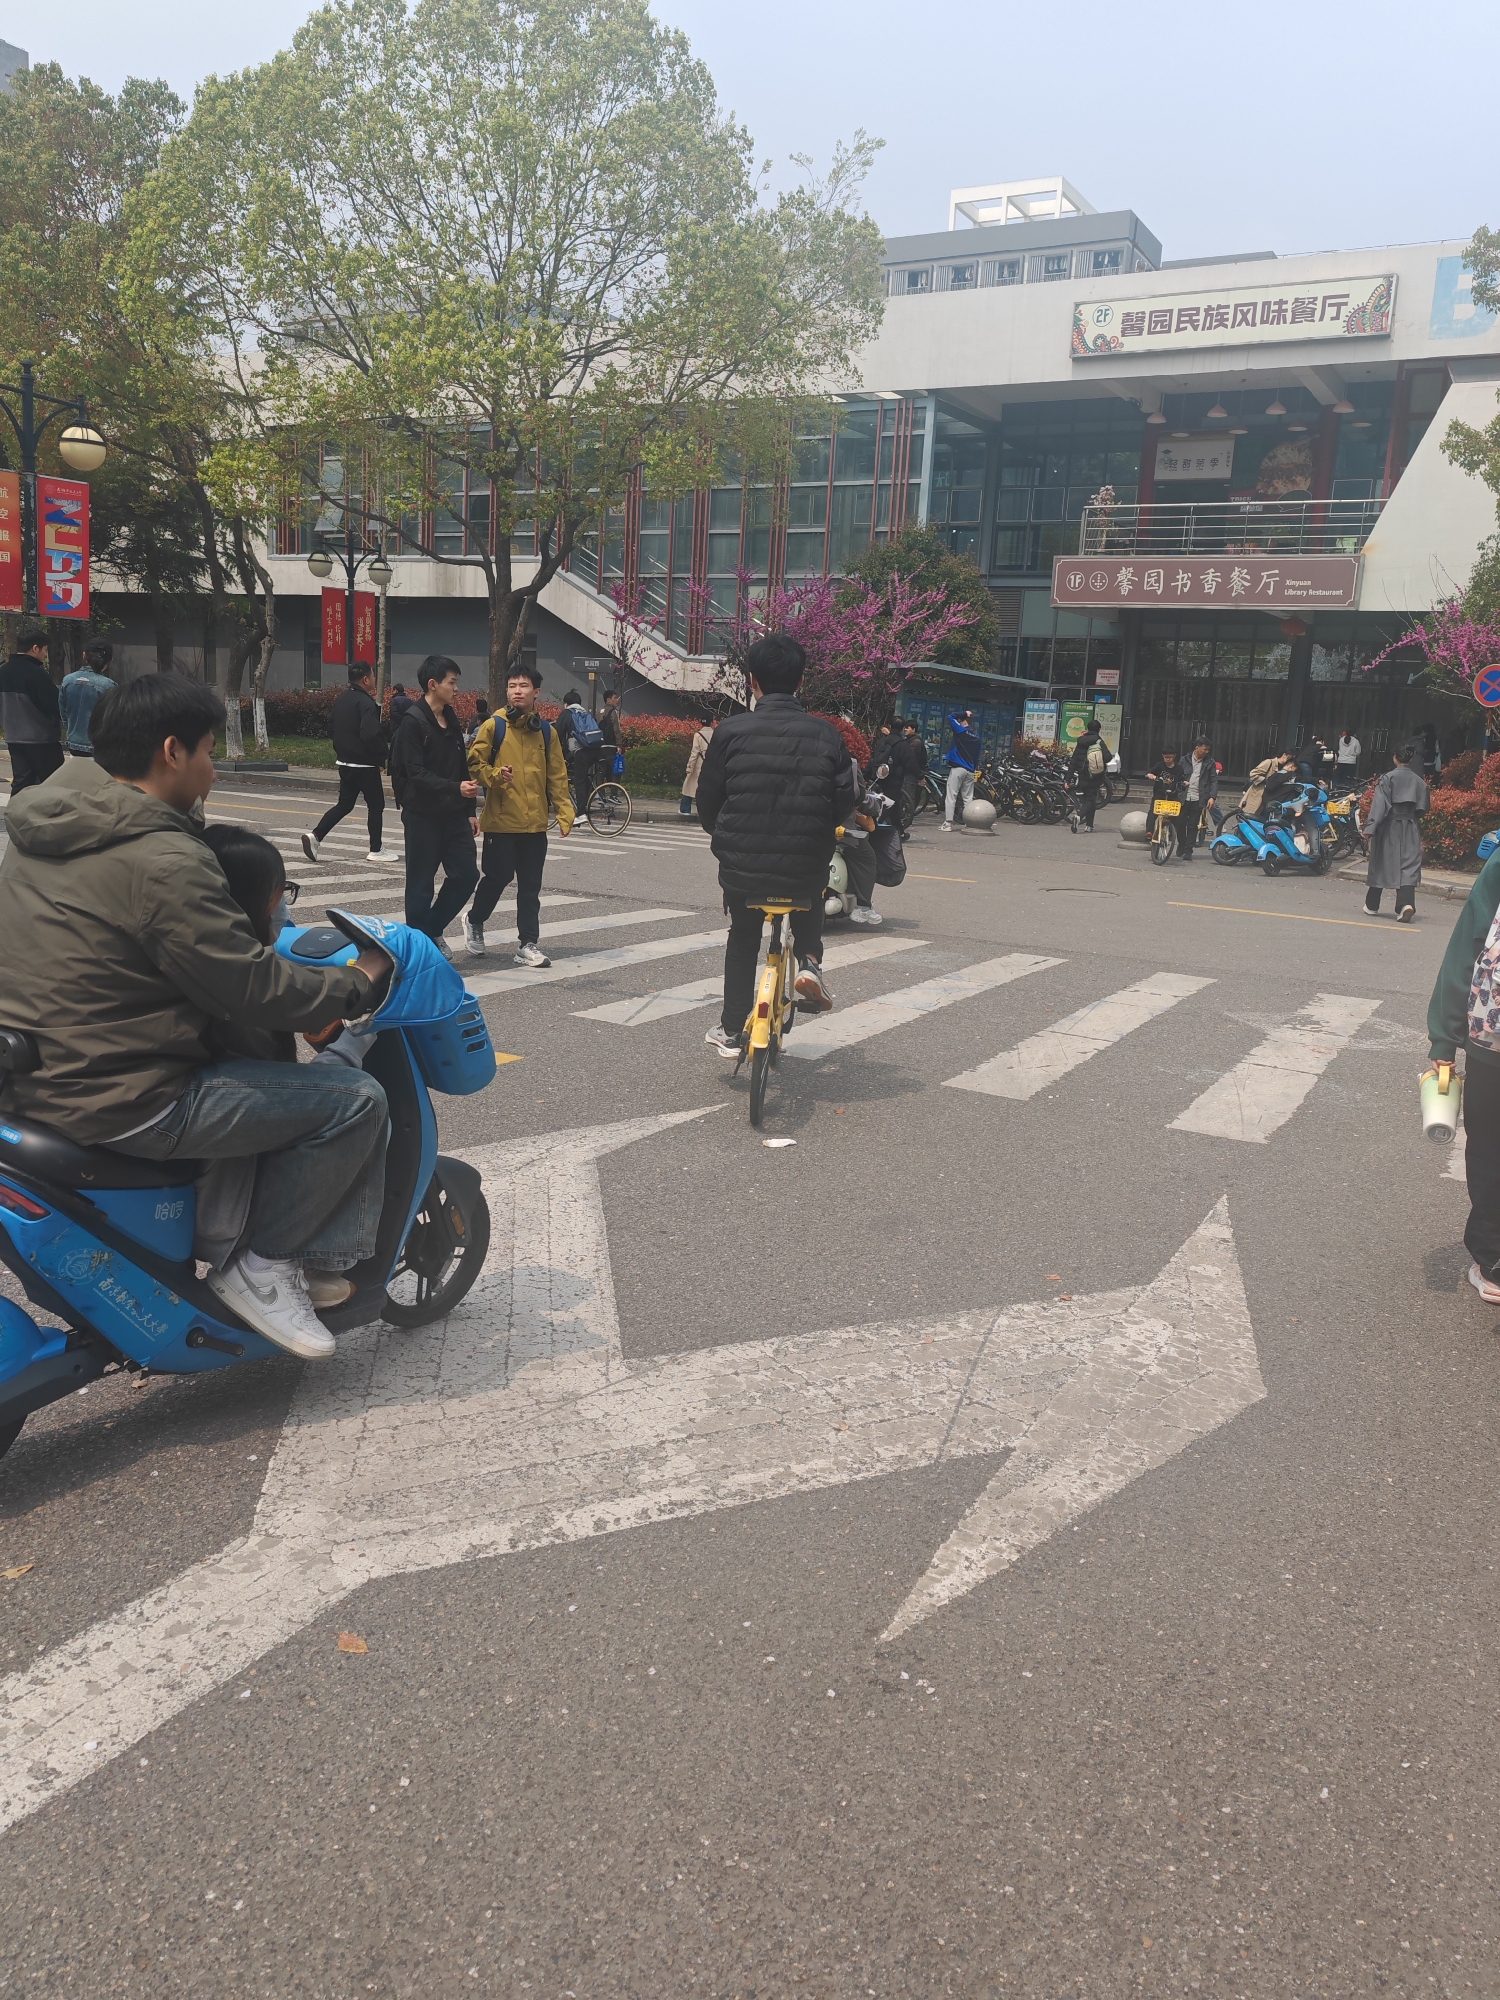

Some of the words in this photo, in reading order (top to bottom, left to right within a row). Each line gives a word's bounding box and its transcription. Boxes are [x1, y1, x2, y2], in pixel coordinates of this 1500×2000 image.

[1096, 308, 1110, 323] 2F
[1120, 293, 1350, 338] 馨园民族风味餐厅
[1069, 574, 1082, 588] 1F
[1113, 566, 1280, 597] 馨园书香餐厅
[1285, 579, 1312, 588] Xinyuan
[1284, 588, 1308, 597] Library
